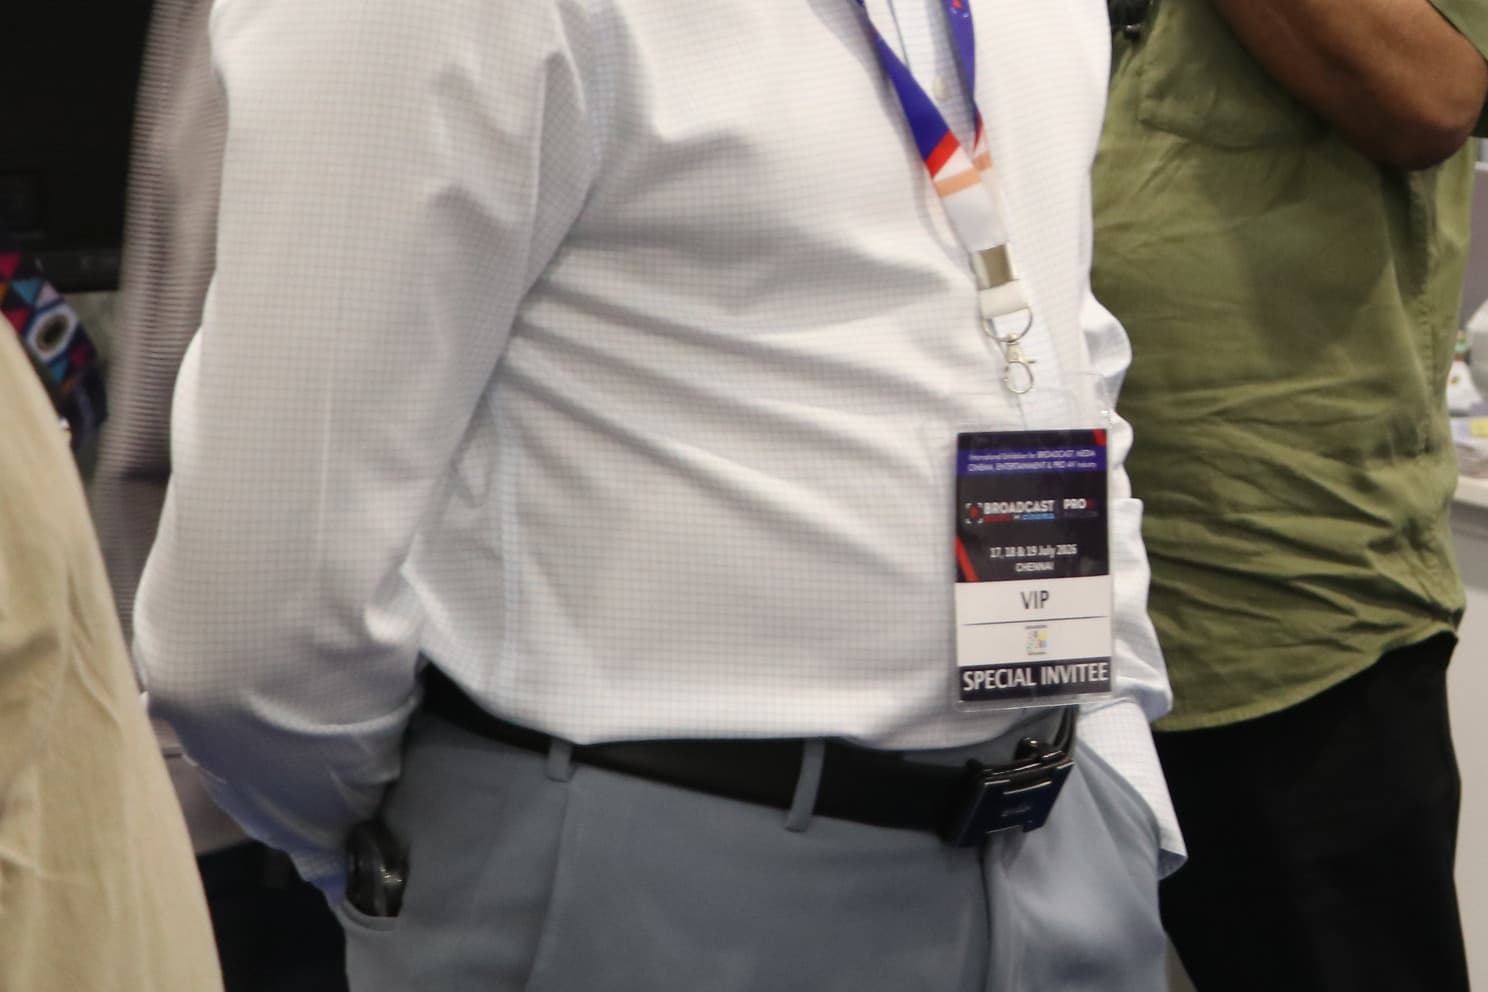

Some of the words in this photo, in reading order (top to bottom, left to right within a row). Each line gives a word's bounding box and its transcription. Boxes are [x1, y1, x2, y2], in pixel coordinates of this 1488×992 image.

[983, 499, 1056, 515] BROADCAST
[1063, 498, 1087, 510] PRO
[1020, 590, 1050, 610] VIP
[962, 668, 1037, 691] SPECIAL
[1040, 662, 1110, 685] INVITEE
